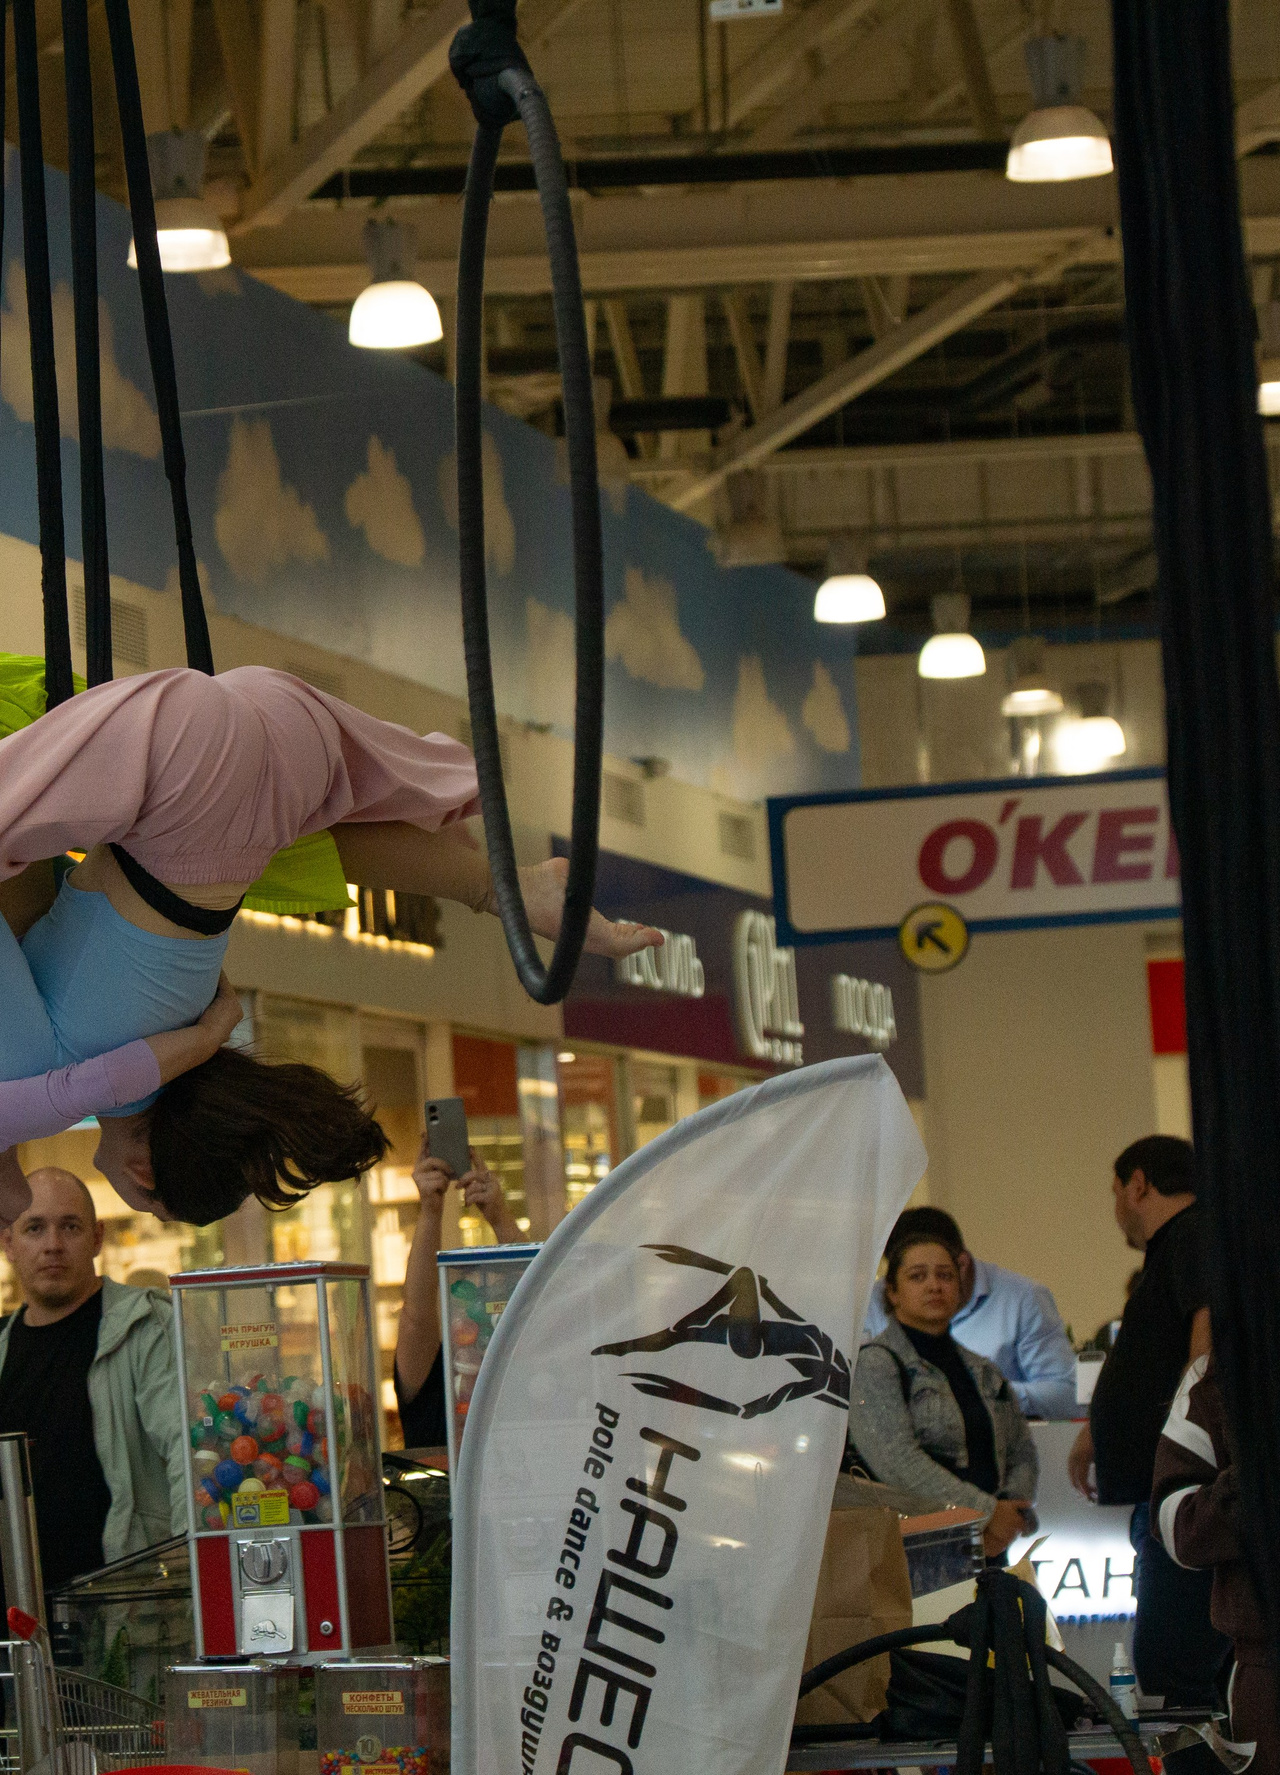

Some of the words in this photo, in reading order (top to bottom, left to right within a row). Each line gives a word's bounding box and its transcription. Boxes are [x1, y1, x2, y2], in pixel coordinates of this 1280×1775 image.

[229, 1338, 272, 1349] ИГРУШКА
[584, 1402, 620, 1480] pole
[555, 1486, 600, 1590] dance
[547, 1597, 574, 1621] &
[202, 1699, 232, 1707] РЕЗИНКА
[349, 1693, 394, 1702] КОНФЕТЫ
[345, 1705, 384, 1713] НЕСКОЛЬКО
[385, 1705, 404, 1713] ШТУК
